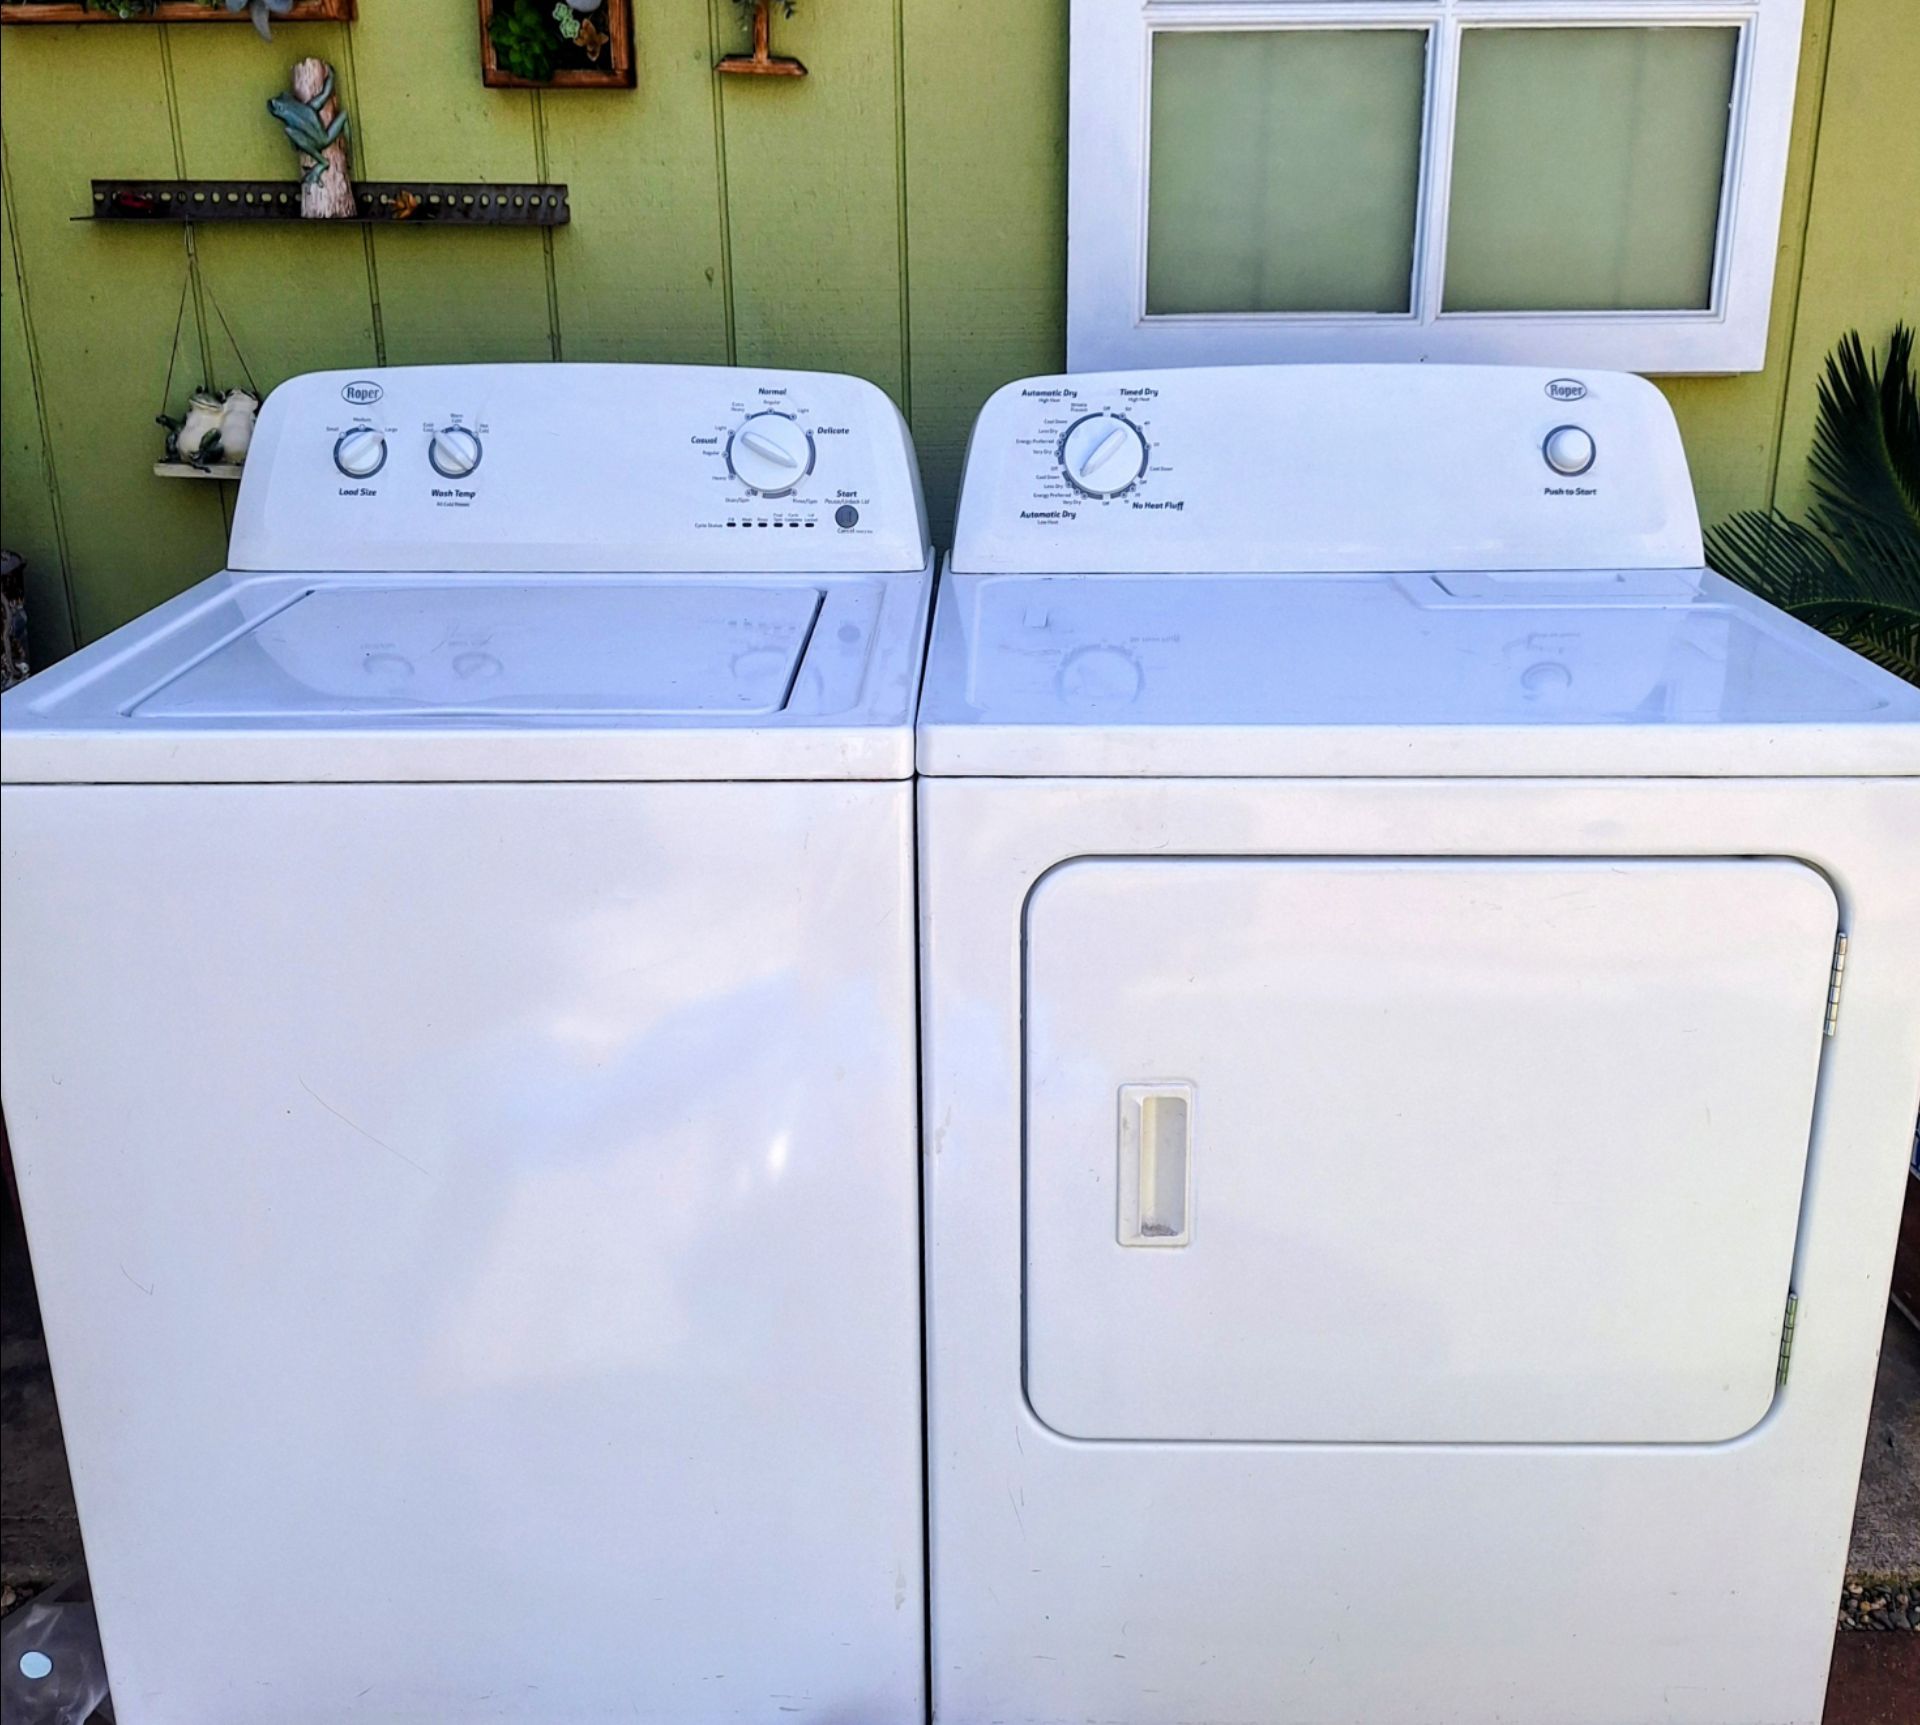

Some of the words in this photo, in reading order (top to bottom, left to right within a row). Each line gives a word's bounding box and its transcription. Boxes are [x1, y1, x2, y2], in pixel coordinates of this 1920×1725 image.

[347, 387, 380, 401] Roper
[758, 387, 787, 395] Normal
[1021, 388, 1062, 397] Automatic
[1063, 388, 1078, 399] Dry
[1120, 388, 1143, 396] Timed
[1144, 388, 1159, 397] Dry
[1550, 384, 1583, 398] Roper
[817, 427, 850, 435] Delicate
[690, 435, 718, 444] Casual
[338, 488, 359, 496] Load
[360, 488, 377, 496] Size
[431, 489, 453, 497] Wash
[455, 489, 476, 500] Temp
[836, 489, 857, 498] Start
[1544, 487, 1564, 496] Push
[1565, 488, 1574, 496] to
[1575, 487, 1597, 496] Start
[1132, 501, 1143, 509] No
[1144, 502, 1163, 510] Heat
[1164, 501, 1184, 511] Fluff
[1019, 510, 1061, 519] Automatic
[1062, 510, 1077, 520] Dry
